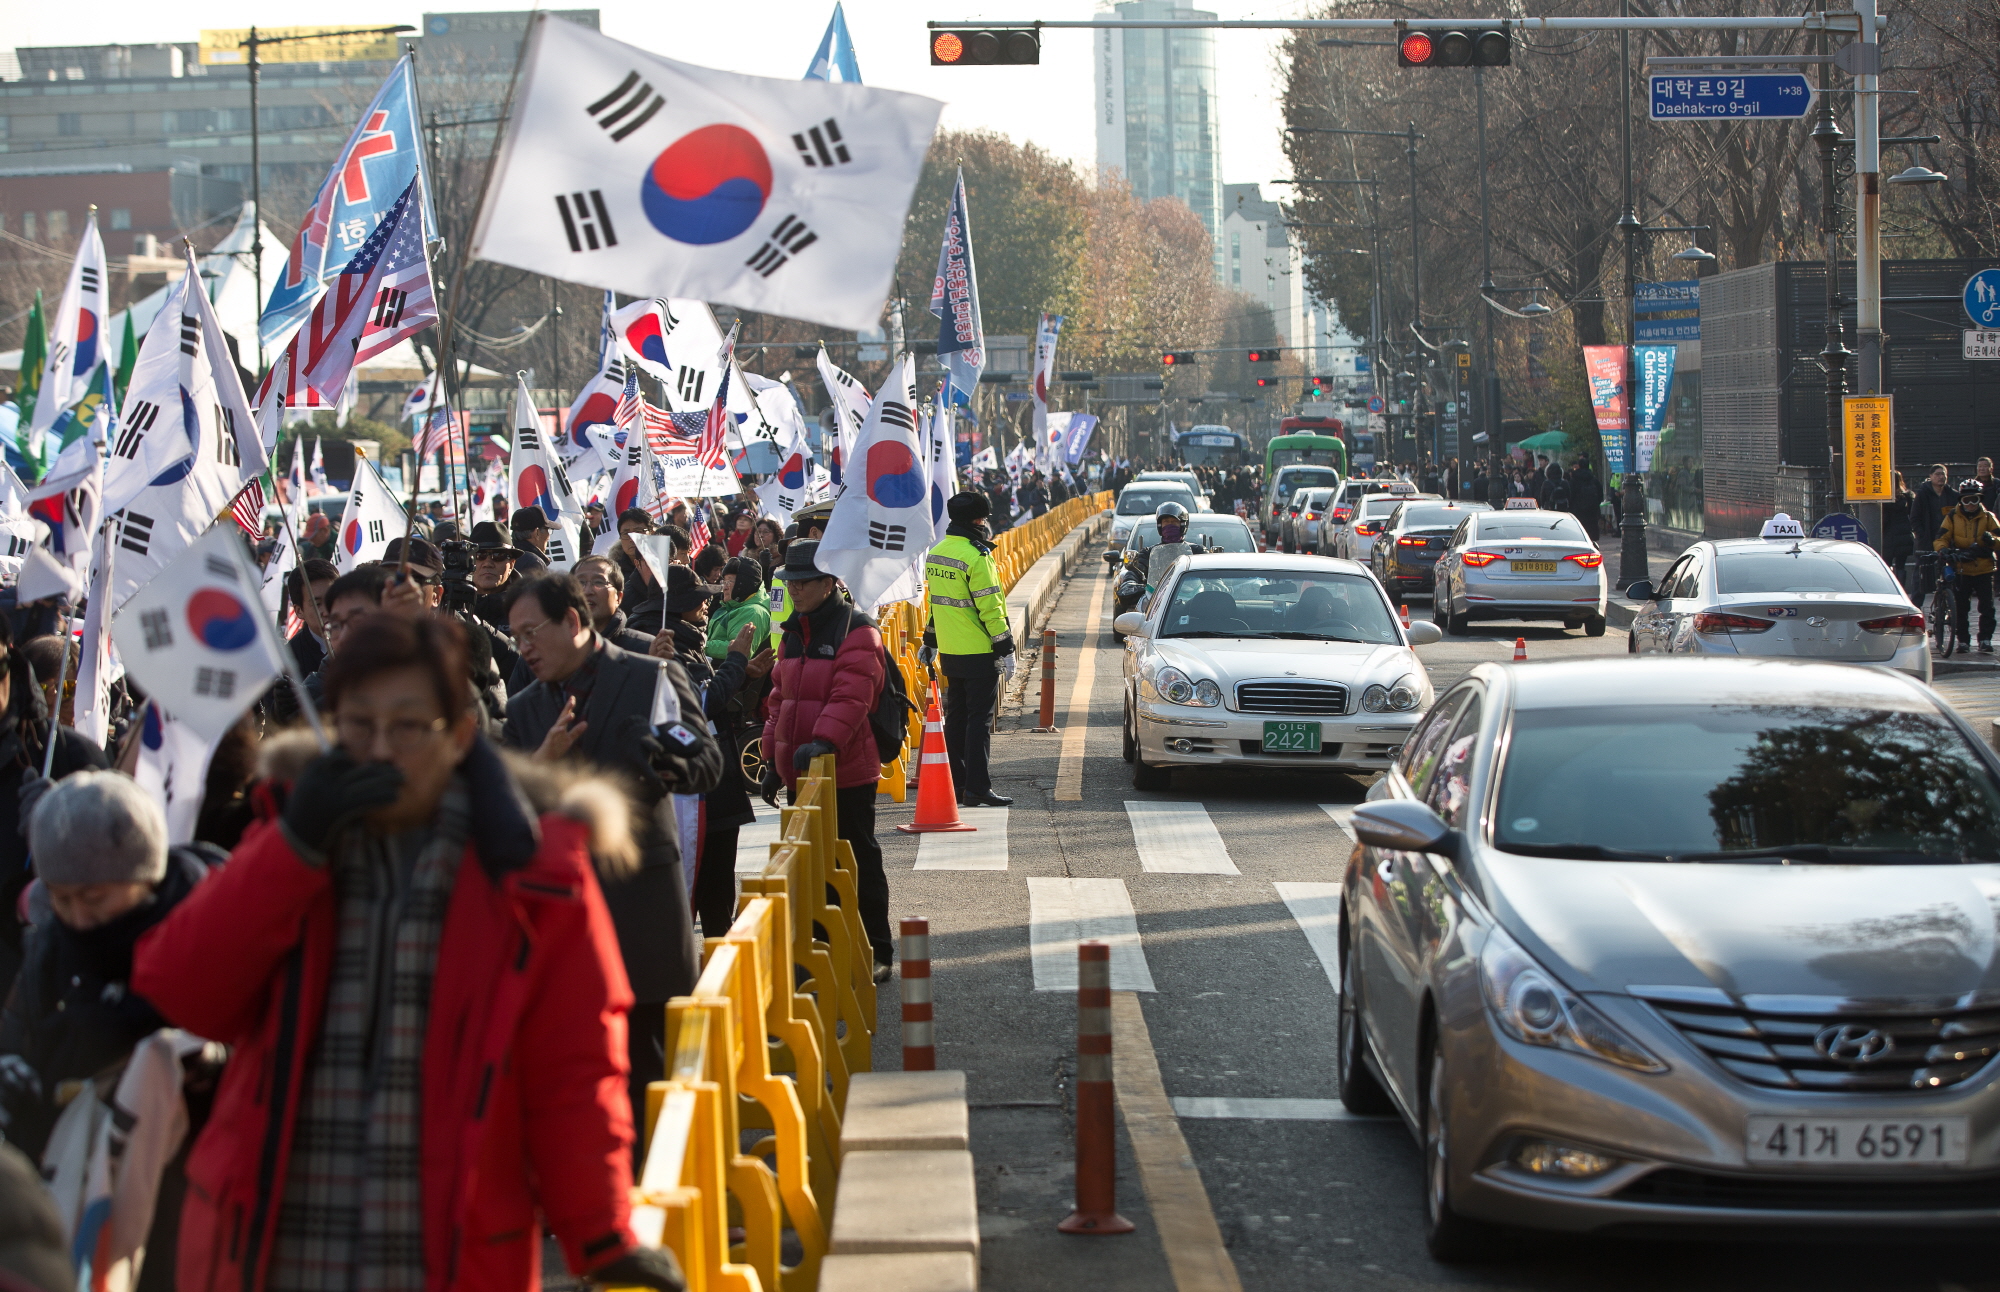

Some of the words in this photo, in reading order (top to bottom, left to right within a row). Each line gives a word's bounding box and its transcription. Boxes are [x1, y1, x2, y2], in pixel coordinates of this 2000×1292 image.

[1656, 79, 1746, 99] 대학로9길
[1656, 102, 1726, 114] Daehak-ro
[1729, 101, 1760, 116] 9-gil
[951, 301, 975, 343] 한미동맹
[1638, 327, 1674, 338] 서울대학교
[1966, 345, 1996, 357] 이곳에서
[1657, 351, 1667, 374] 2017
[1644, 350, 1656, 407] Christmas
[1657, 375, 1667, 403] Korea
[1644, 408, 1656, 430] Fair
[1854, 413, 1865, 430] 설치
[1870, 413, 1882, 429] 종로
[1854, 433, 1866, 458] 공사중
[1871, 431, 1882, 461] 중앙버스
[1854, 461, 1866, 494] 우회바람
[1871, 464, 1883, 494] 전용차로
[1772, 525, 1797, 534] TAXI
[927, 567, 956, 580] POLICE
[1265, 731, 1314, 749] 2421
[1765, 1122, 1837, 1157] 41거
[1856, 1124, 1945, 1158] 6591
